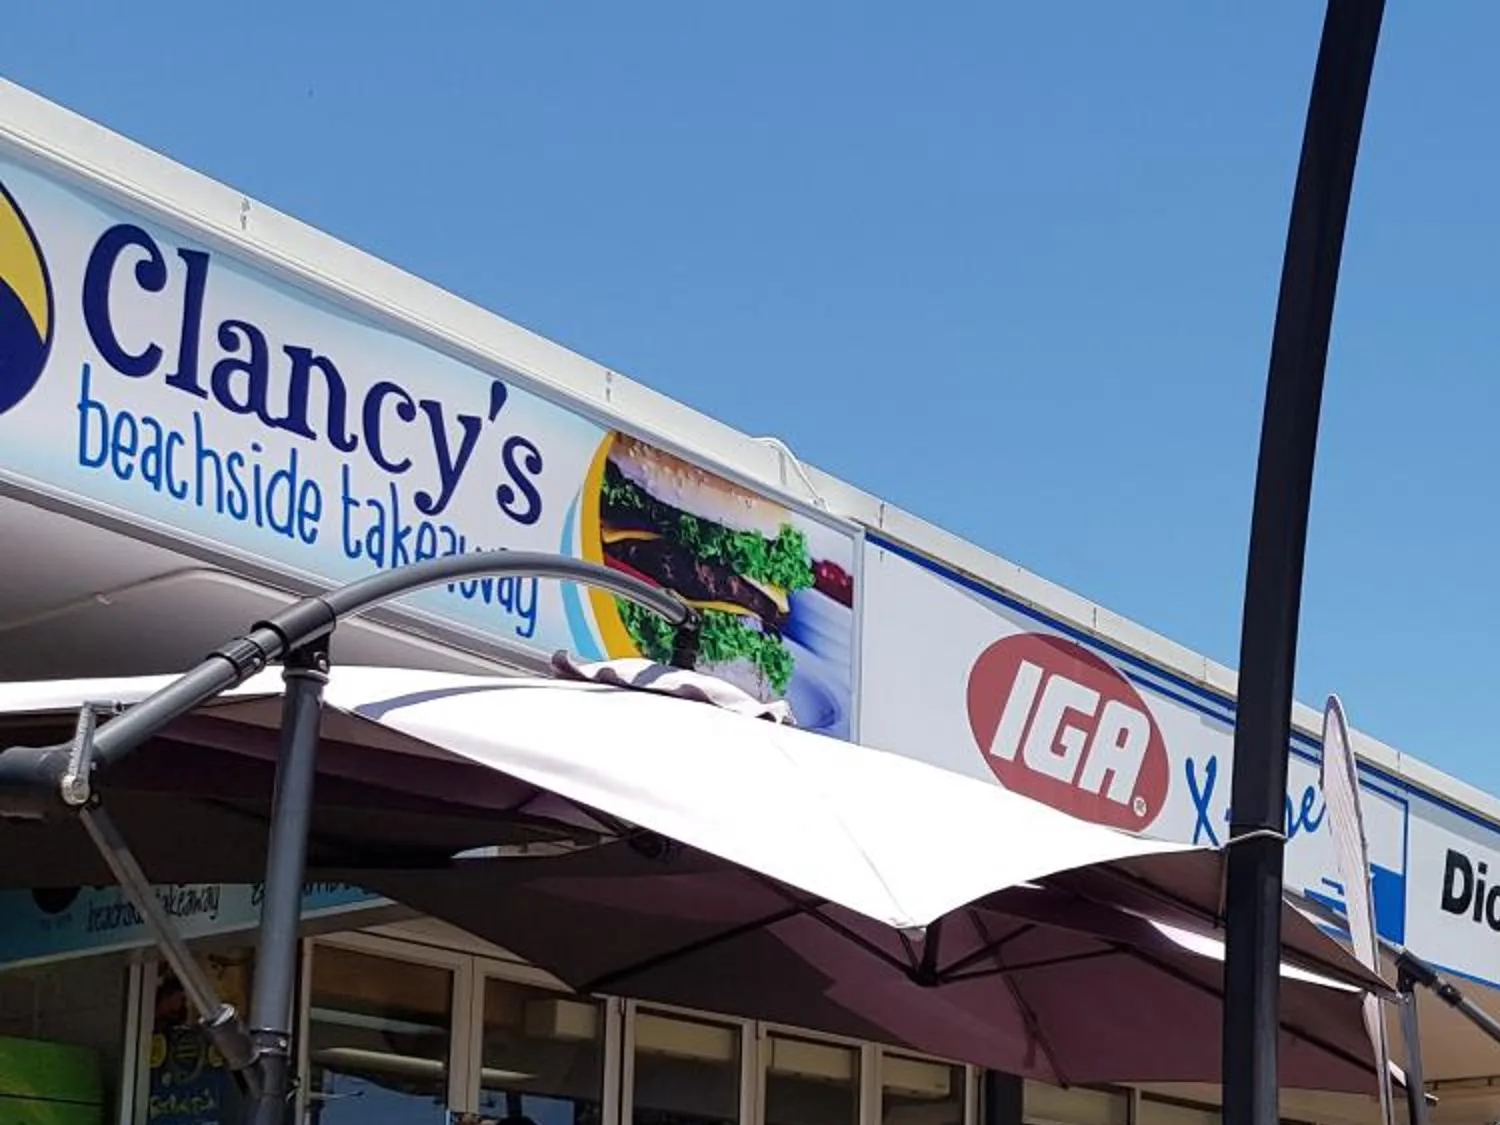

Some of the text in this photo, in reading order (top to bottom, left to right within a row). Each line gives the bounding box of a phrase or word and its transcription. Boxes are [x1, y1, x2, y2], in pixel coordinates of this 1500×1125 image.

[76, 363, 322, 544] beachside
[82, 223, 545, 526] Clancy's
[989, 660, 1151, 806] IGA
